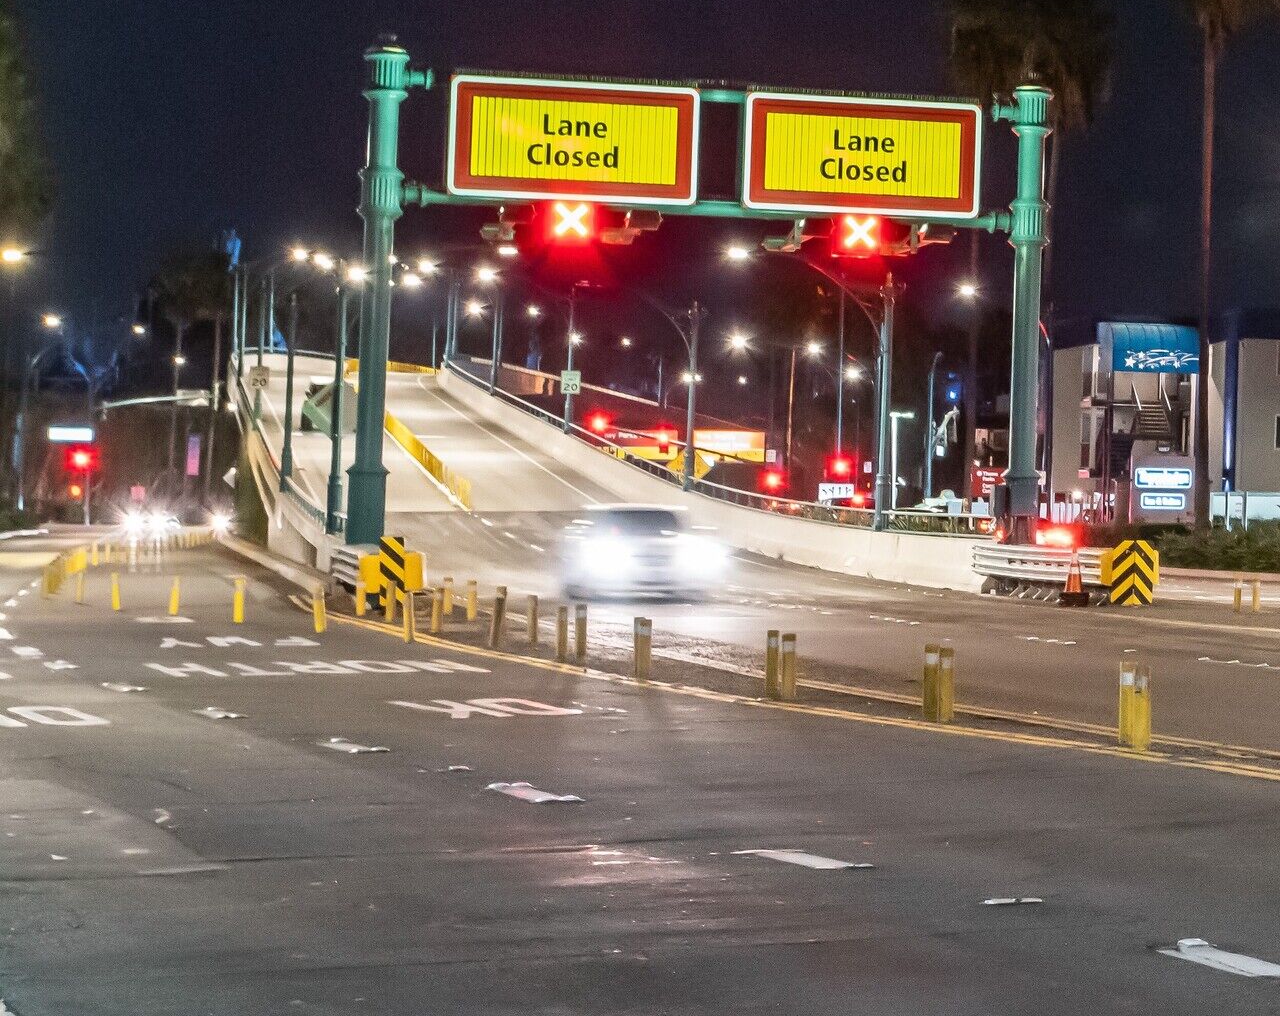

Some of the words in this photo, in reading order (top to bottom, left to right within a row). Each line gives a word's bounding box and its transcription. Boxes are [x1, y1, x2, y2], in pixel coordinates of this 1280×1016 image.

[543, 113, 608, 139] Lane
[833, 129, 895, 153] Lane
[527, 142, 620, 169] Closed
[819, 158, 908, 183] Closed
[252, 378, 267, 387] 20
[563, 383, 578, 392] 20
[143, 659, 492, 678] NORTH
